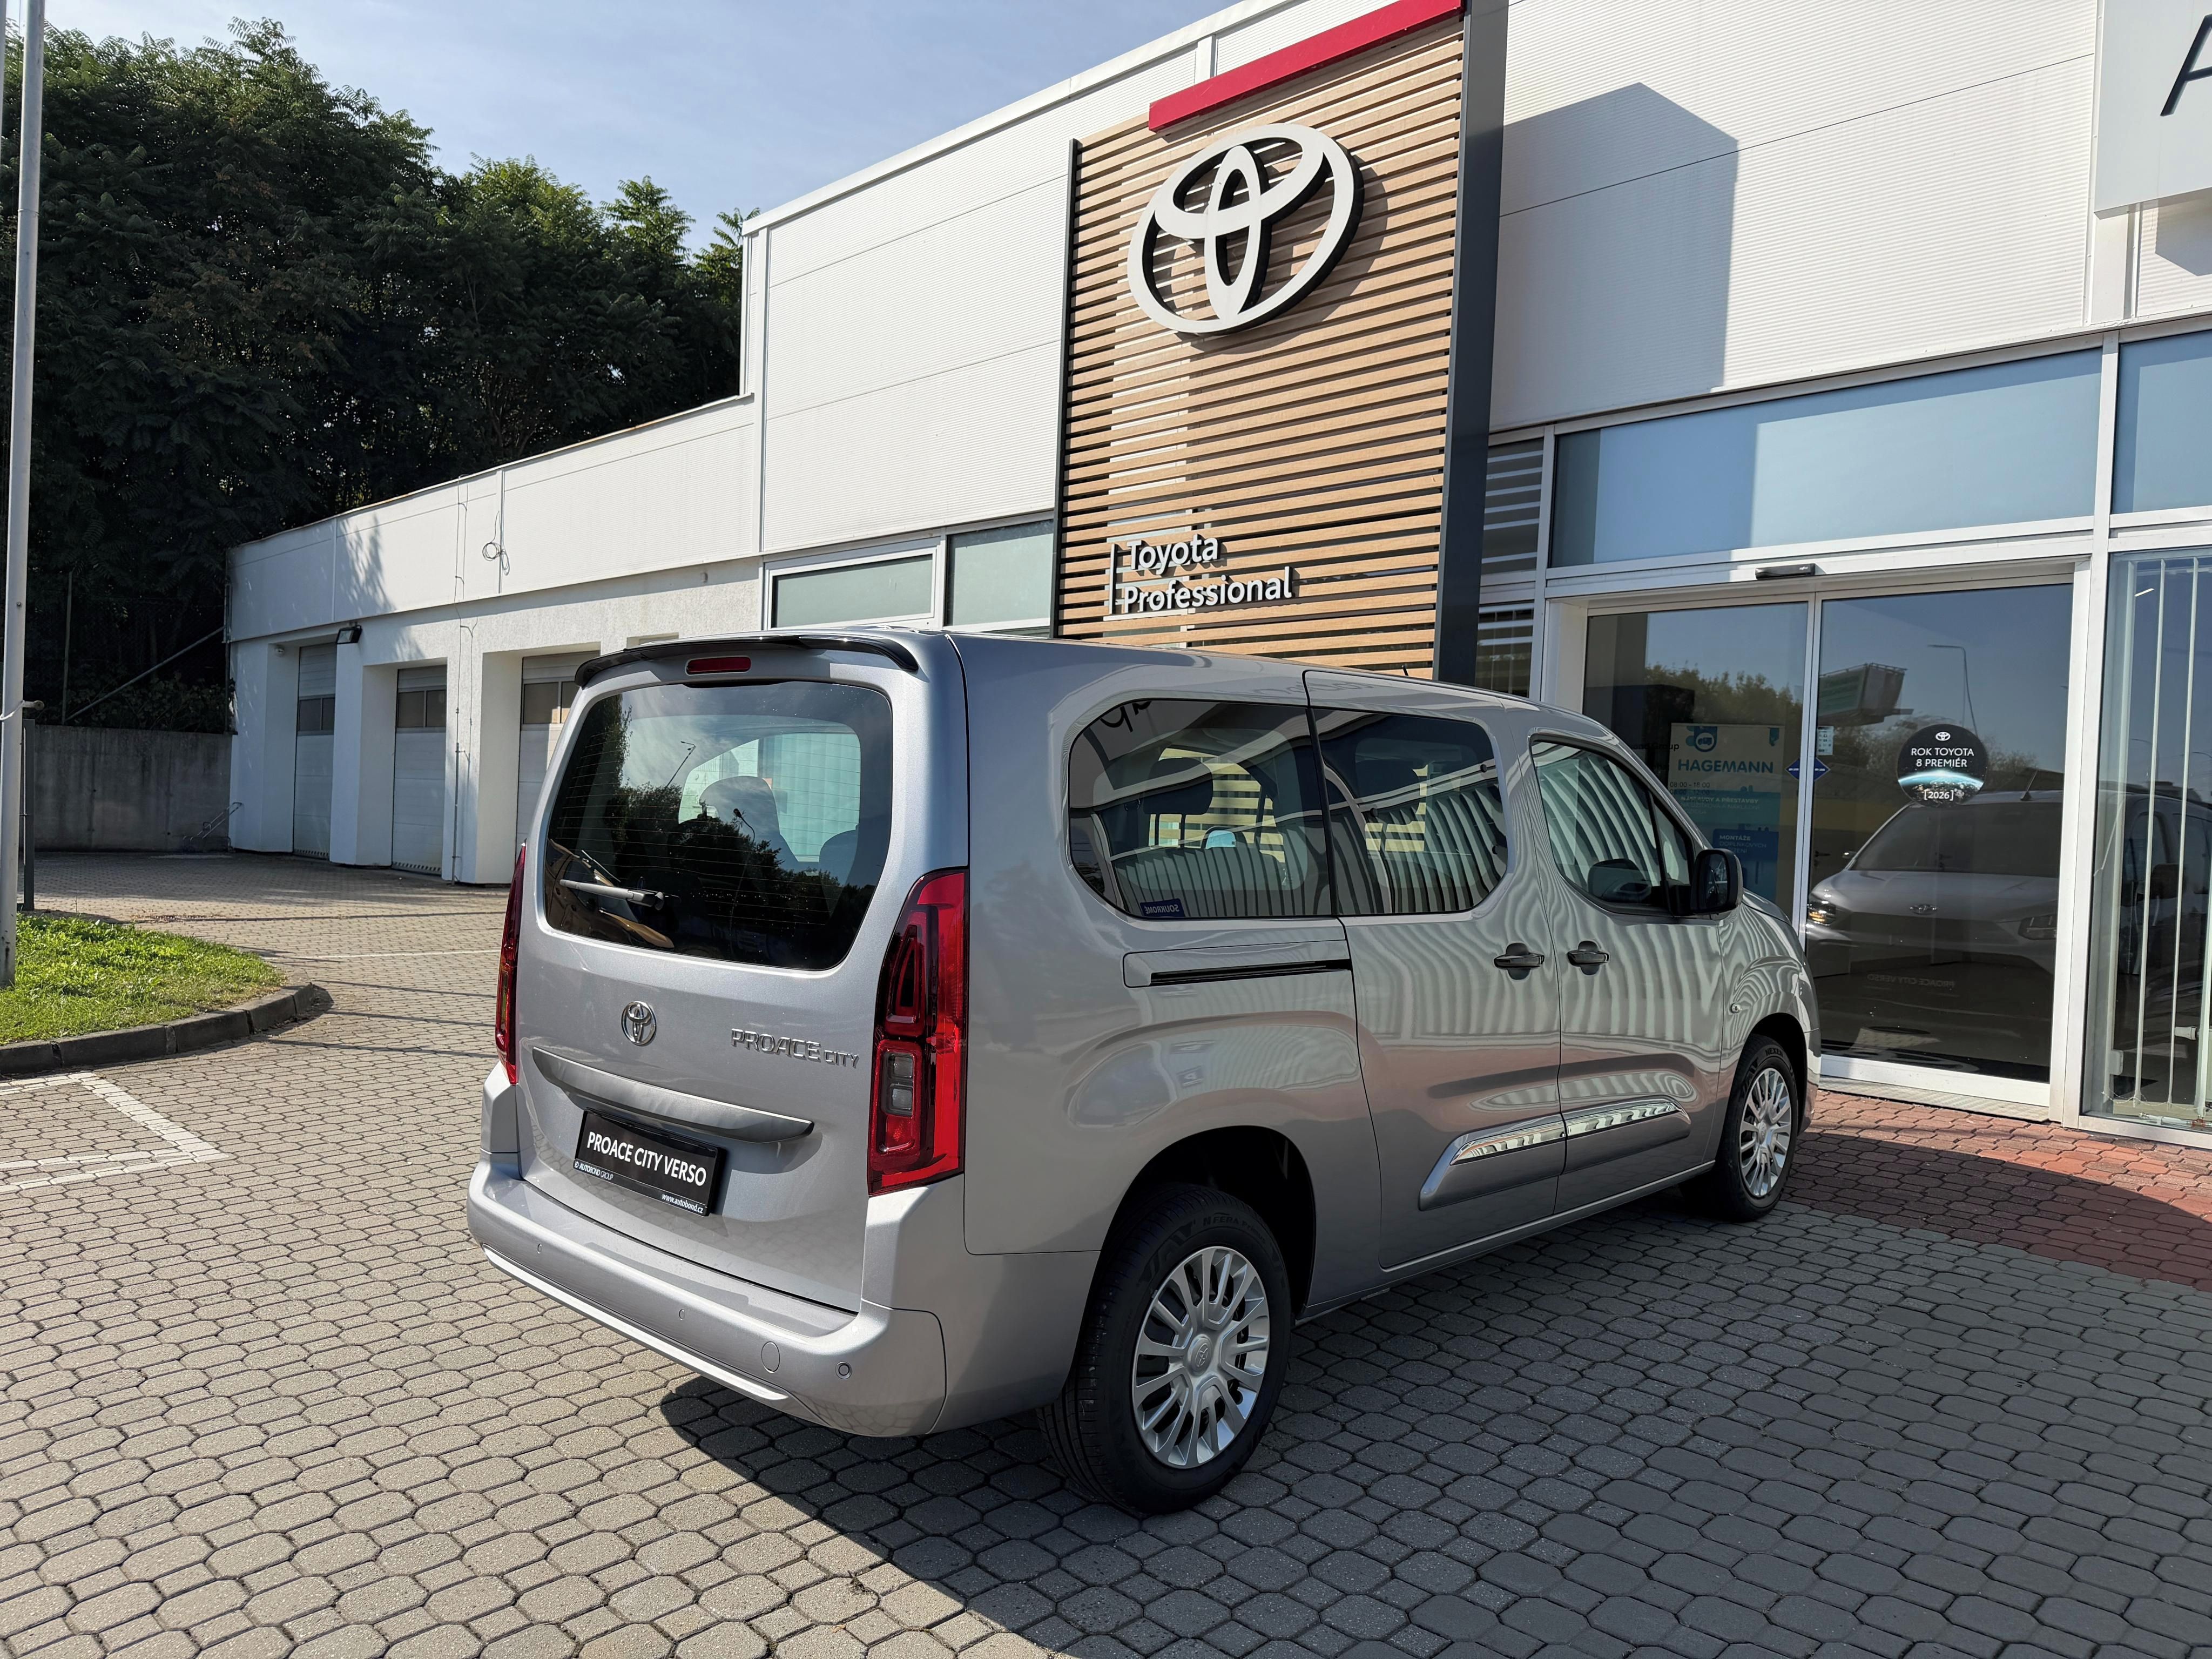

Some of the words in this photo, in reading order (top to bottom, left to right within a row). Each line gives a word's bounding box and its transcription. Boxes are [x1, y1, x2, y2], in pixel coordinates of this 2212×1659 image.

[1127, 534, 1219, 575] Toyota
[1124, 566, 1292, 613] Professional
[1911, 748, 1932, 756] ROK
[1935, 748, 1974, 756] TOYOTA
[1678, 759, 1773, 773] HAGEMANN
[1916, 759, 1922, 767] 8
[1925, 757, 1967, 767] PREMIÉR
[1924, 790, 1954, 801] [2026]
[731, 1028, 821, 1063] PROACE
[824, 1050, 860, 1068] CITY
[587, 1131, 634, 1162] PROACE
[635, 1148, 663, 1171] CITY
[664, 1156, 707, 1186] VERSO
[579, 1163, 601, 1176] AUTOBOND
[600, 1172, 613, 1181] GROUP
[662, 1193, 704, 1214] www.autobond.cz
